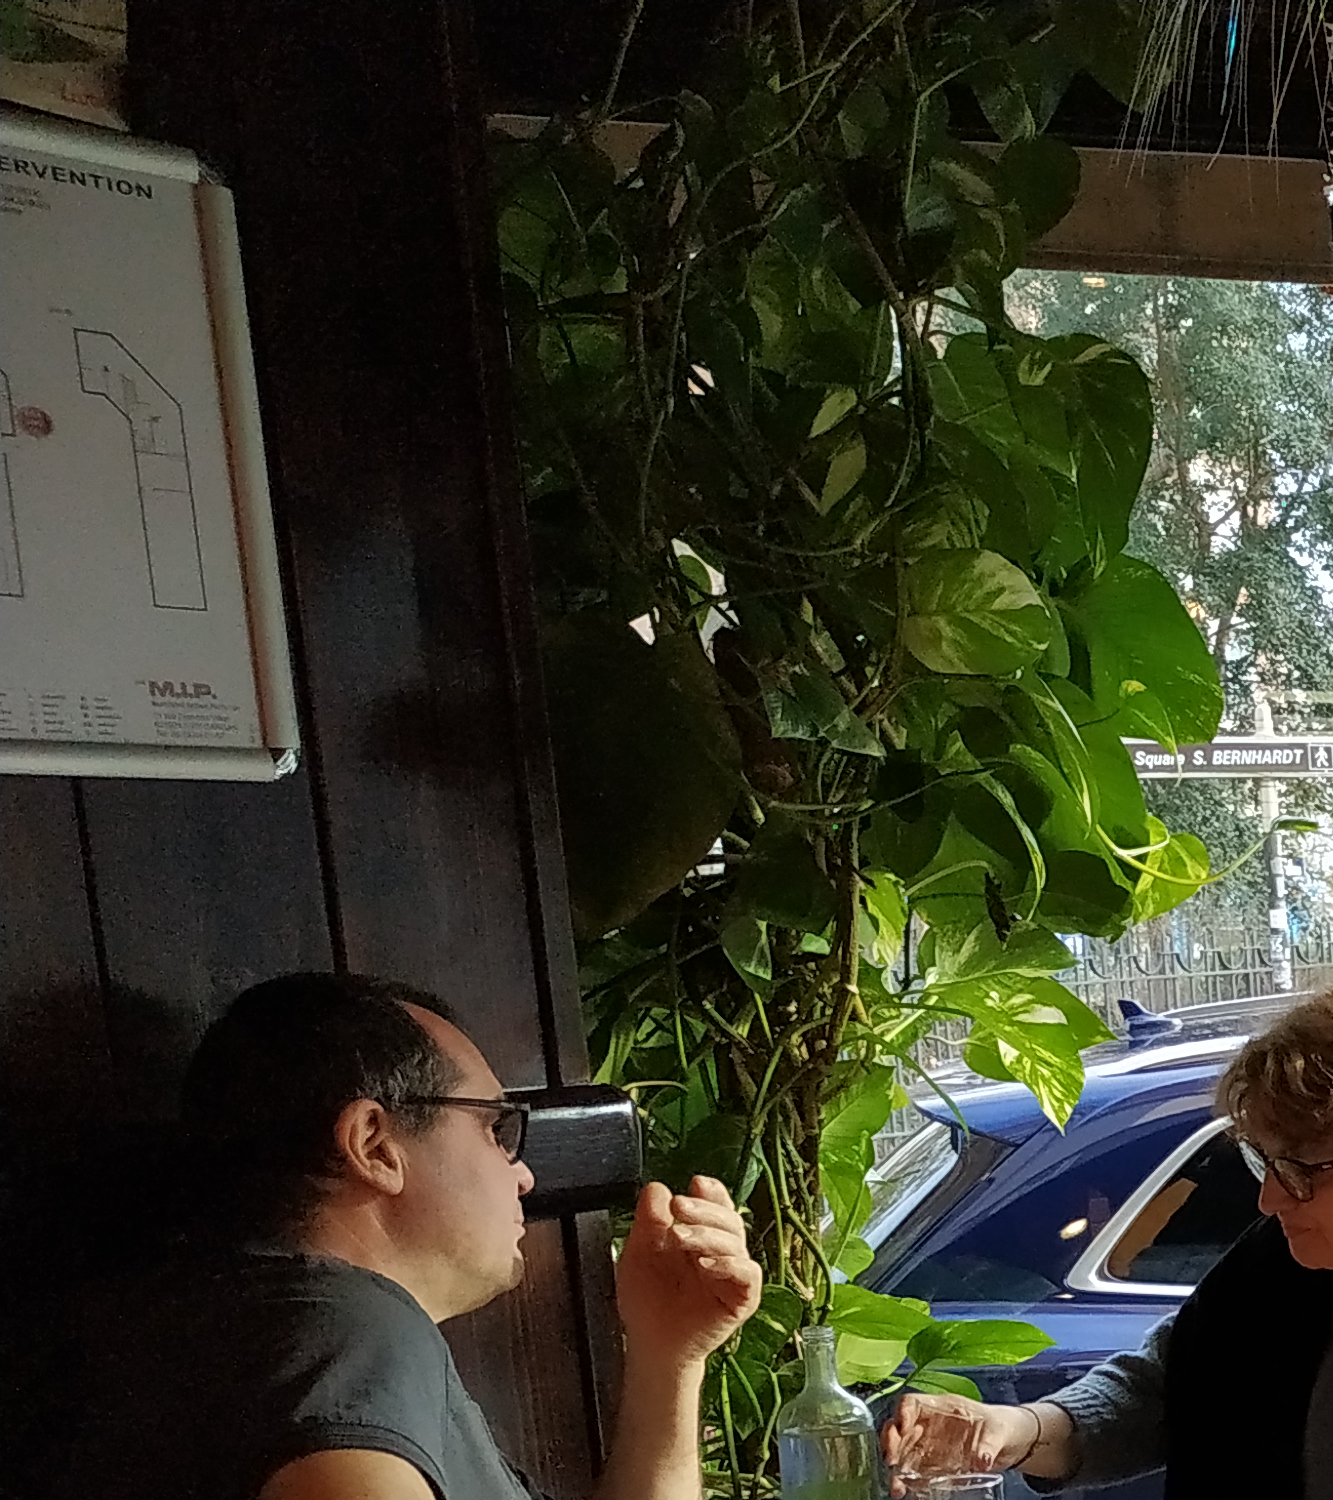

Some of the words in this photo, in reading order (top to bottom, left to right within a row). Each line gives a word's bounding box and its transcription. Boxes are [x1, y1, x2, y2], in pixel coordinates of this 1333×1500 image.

[1134, 750, 1185, 770] Square
[1192, 749, 1208, 766] S.
[1212, 748, 1304, 766] BERNHARDT
